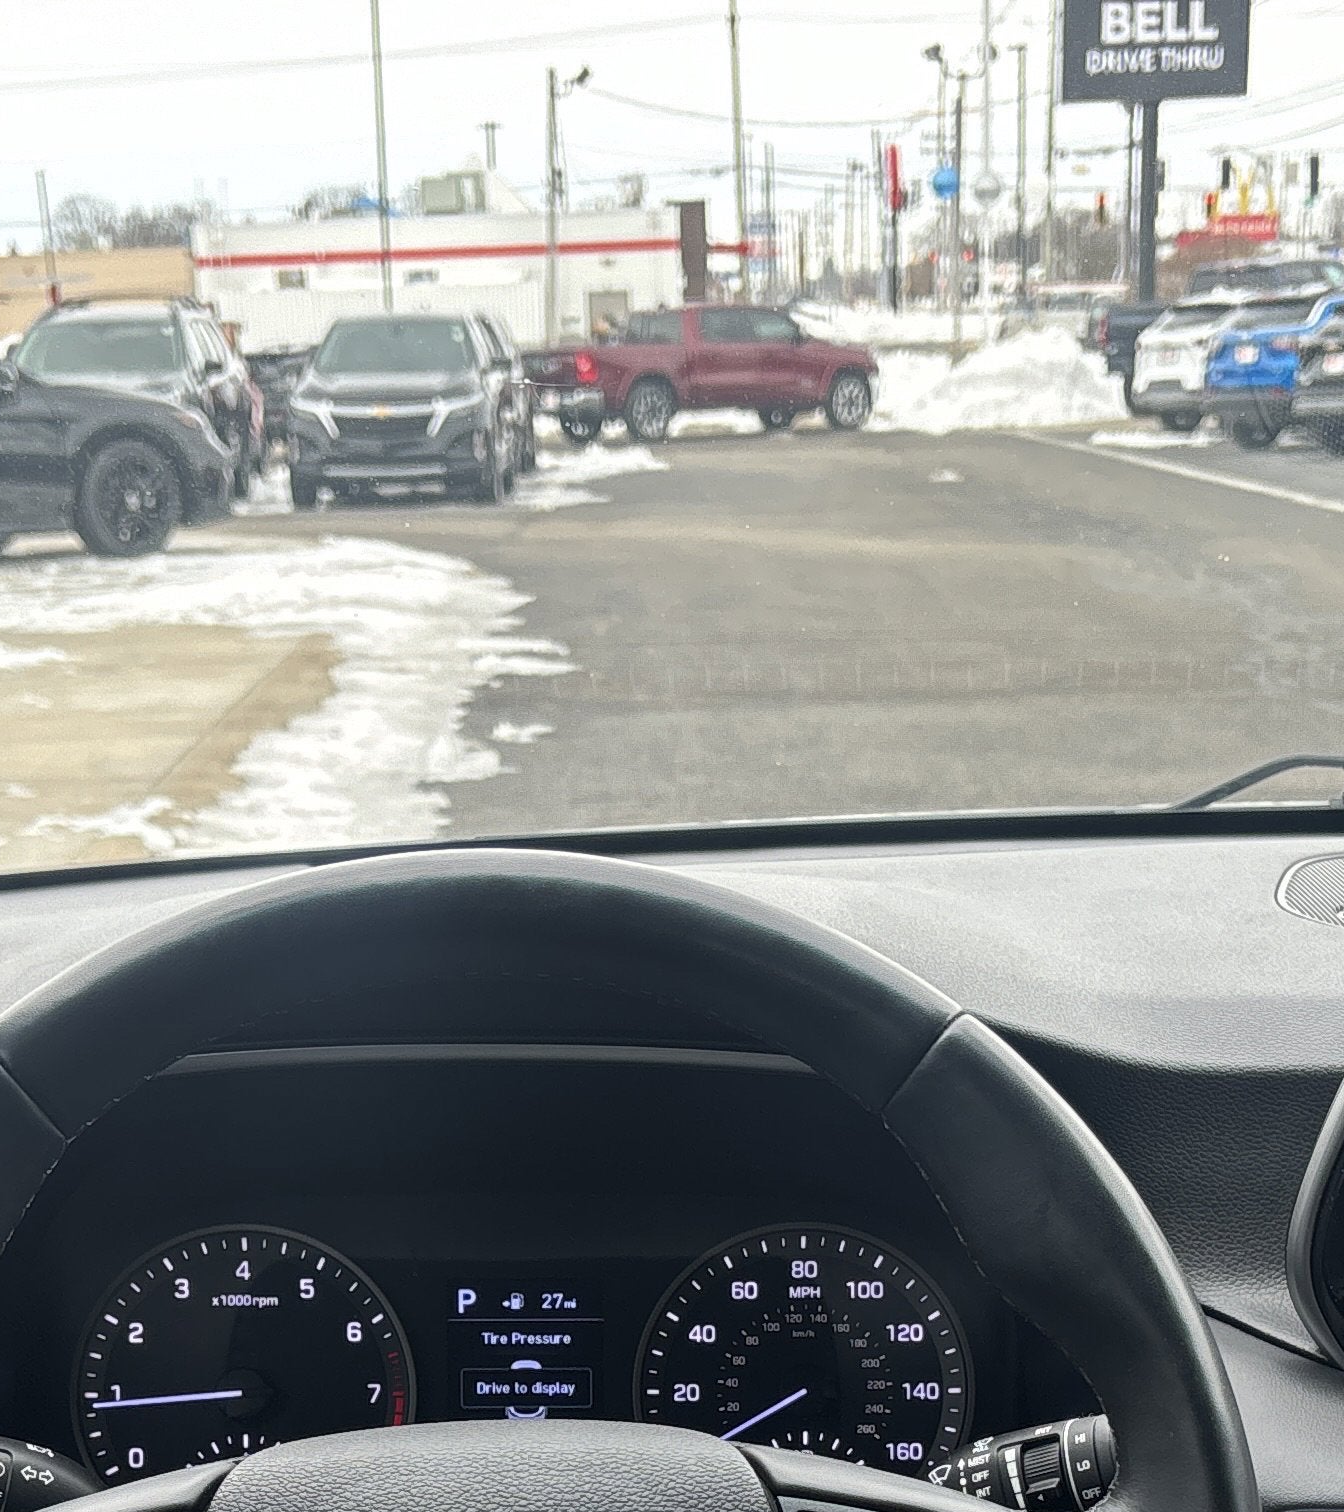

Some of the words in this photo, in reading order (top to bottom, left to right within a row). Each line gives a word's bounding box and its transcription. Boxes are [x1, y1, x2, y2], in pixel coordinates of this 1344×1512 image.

[1100, 1, 1219, 44] BELL
[1085, 47, 1156, 75] DRIVE
[1158, 44, 1224, 71] THRU
[235, 1260, 251, 1281] 4
[791, 1260, 818, 1280] 80
[174, 1278, 190, 1299] 3
[300, 1278, 315, 1299] 5
[731, 1281, 758, 1300] 60
[789, 1286, 821, 1300] MPH
[846, 1280, 884, 1300] 100
[458, 1288, 477, 1314] P
[785, 1314, 802, 1323] 120
[810, 1314, 827, 1323] 140
[129, 1322, 144, 1343] 2
[346, 1321, 362, 1342] 6
[688, 1324, 716, 1343] 40
[762, 1323, 780, 1332] 100
[832, 1323, 850, 1332] 160
[886, 1324, 923, 1343] 120
[481, 1332, 507, 1345] Tire
[511, 1332, 571, 1345] Pressure
[745, 1336, 759, 1346] 80
[732, 1356, 746, 1366] 60
[861, 1359, 880, 1368] 200
[476, 1382, 510, 1395] Drive
[514, 1382, 527, 1395] to
[531, 1381, 575, 1396] display
[725, 1378, 739, 1388] 40
[867, 1380, 886, 1390] 220
[111, 1384, 121, 1401] 1
[367, 1383, 381, 1404] 7
[673, 1383, 700, 1402] 20
[902, 1382, 939, 1401] 140
[726, 1402, 740, 1412] 20
[865, 1404, 884, 1414] 240
[856, 1424, 876, 1434] 260
[1074, 1433, 1086, 1445] HI
[129, 1447, 144, 1468] 0
[886, 1442, 923, 1461] 160
[1077, 1460, 1091, 1472] LO
[971, 1470, 990, 1483] OFF
[1082, 1487, 1102, 1500] OFF
